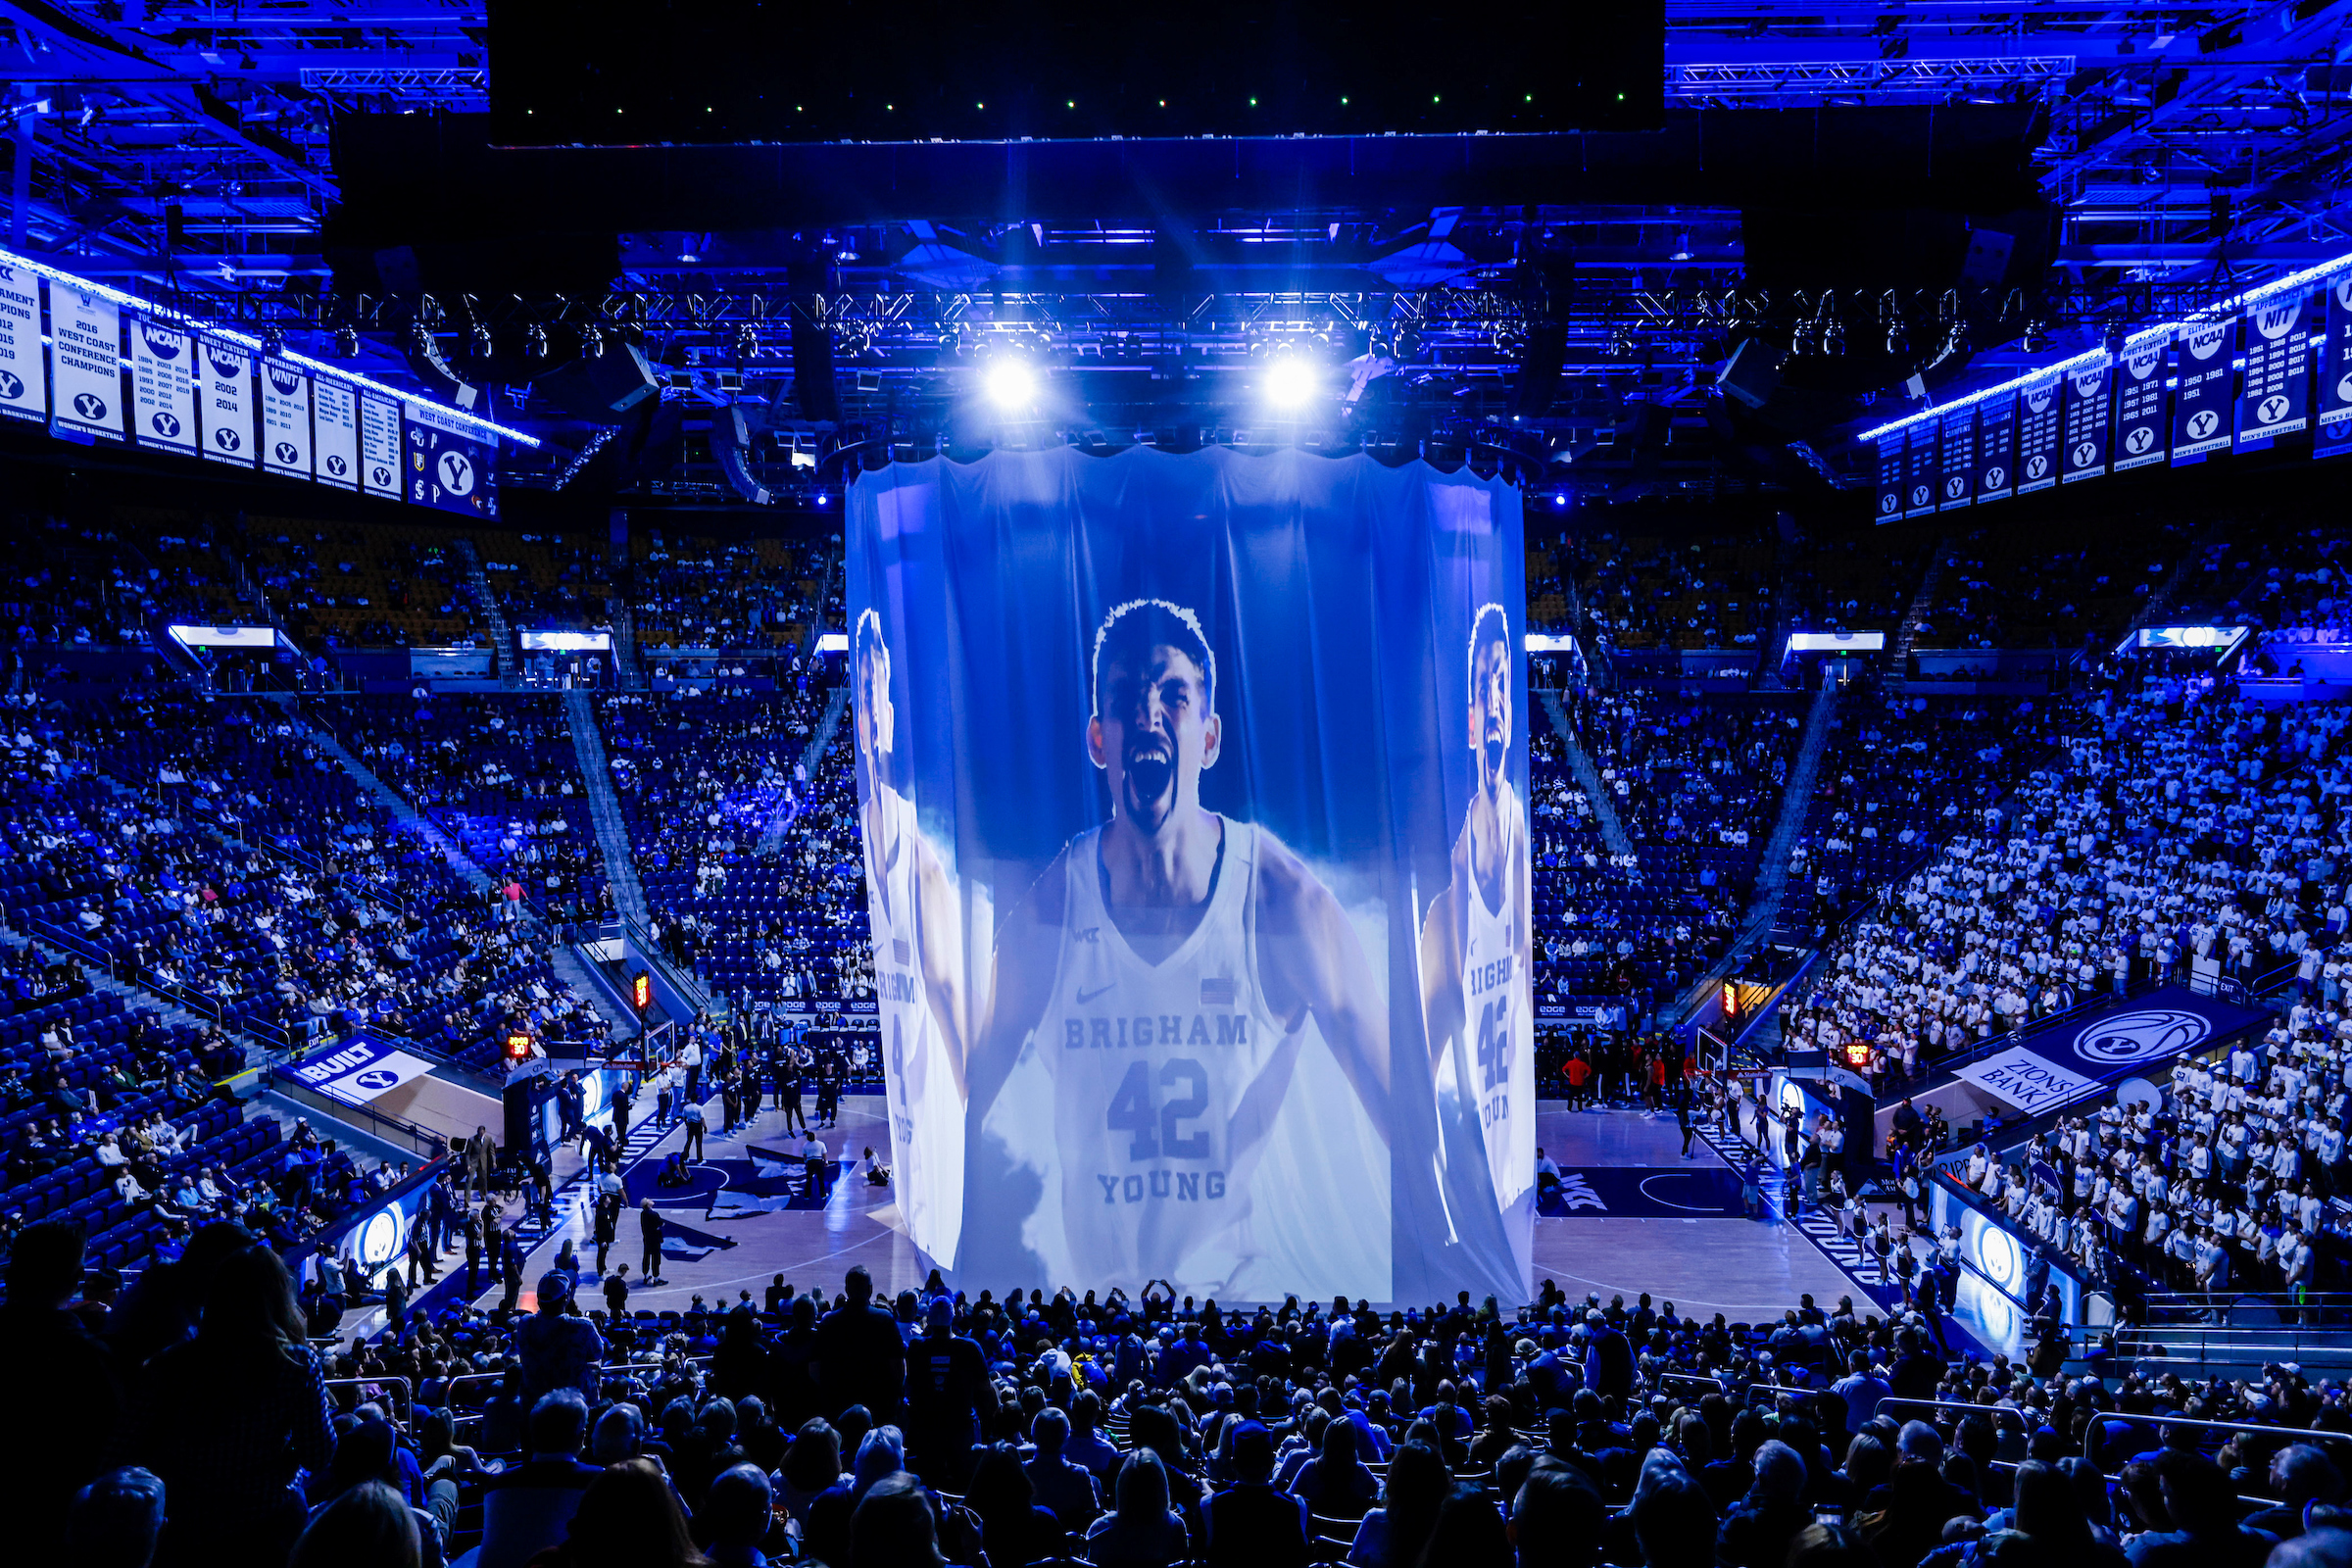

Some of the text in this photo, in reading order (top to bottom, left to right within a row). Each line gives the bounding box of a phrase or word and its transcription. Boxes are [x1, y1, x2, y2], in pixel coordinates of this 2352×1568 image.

[76, 319, 98, 334] 2016
[2263, 305, 2295, 330] NIT
[58, 326, 116, 353] WEST COAST
[146, 325, 180, 350] NCAA
[2193, 328, 2224, 351] NCAA
[2249, 344, 2264, 356] 1951
[2289, 331, 2307, 343] 2013
[59, 341, 117, 366] CONFERENCE
[211, 345, 242, 368] NCAA
[2249, 355, 2265, 367] 1953
[2269, 349, 2285, 360] 1994
[61, 355, 116, 378] CHAMPIONS
[2248, 354, 2305, 377] 1954 2000 2017
[271, 367, 299, 388] WNIT
[2079, 370, 2103, 389] NCAA
[2142, 379, 2159, 391] 1971
[2183, 368, 2224, 388] 1950 1981
[2267, 370, 2284, 382] 2002
[216, 381, 237, 396] 2002
[2142, 392, 2158, 404] 1981
[2183, 387, 2201, 401] 1951
[216, 398, 238, 413] 2014
[2141, 405, 2158, 416] 2011
[418, 409, 436, 423] WEST
[437, 416, 455, 428] COAST
[2262, 422, 2304, 437] BASKETBALL
[2192, 439, 2230, 455] BASKETBALL
[2220, 982, 2234, 994] EXIT
[308, 1035, 320, 1049] EXIT
[1064, 1014, 1248, 1050] BRIGHAM
[514, 1045, 525, 1055] 30
[1478, 995, 1508, 1094] 42
[300, 1041, 375, 1082] BUILT
[1851, 1054, 1864, 1064] 30
[2004, 1058, 2075, 1093] ZIONS
[1979, 1068, 2049, 1104] BANK
[1106, 1057, 1211, 1163] 42
[1097, 1170, 1226, 1204] YOUNG
